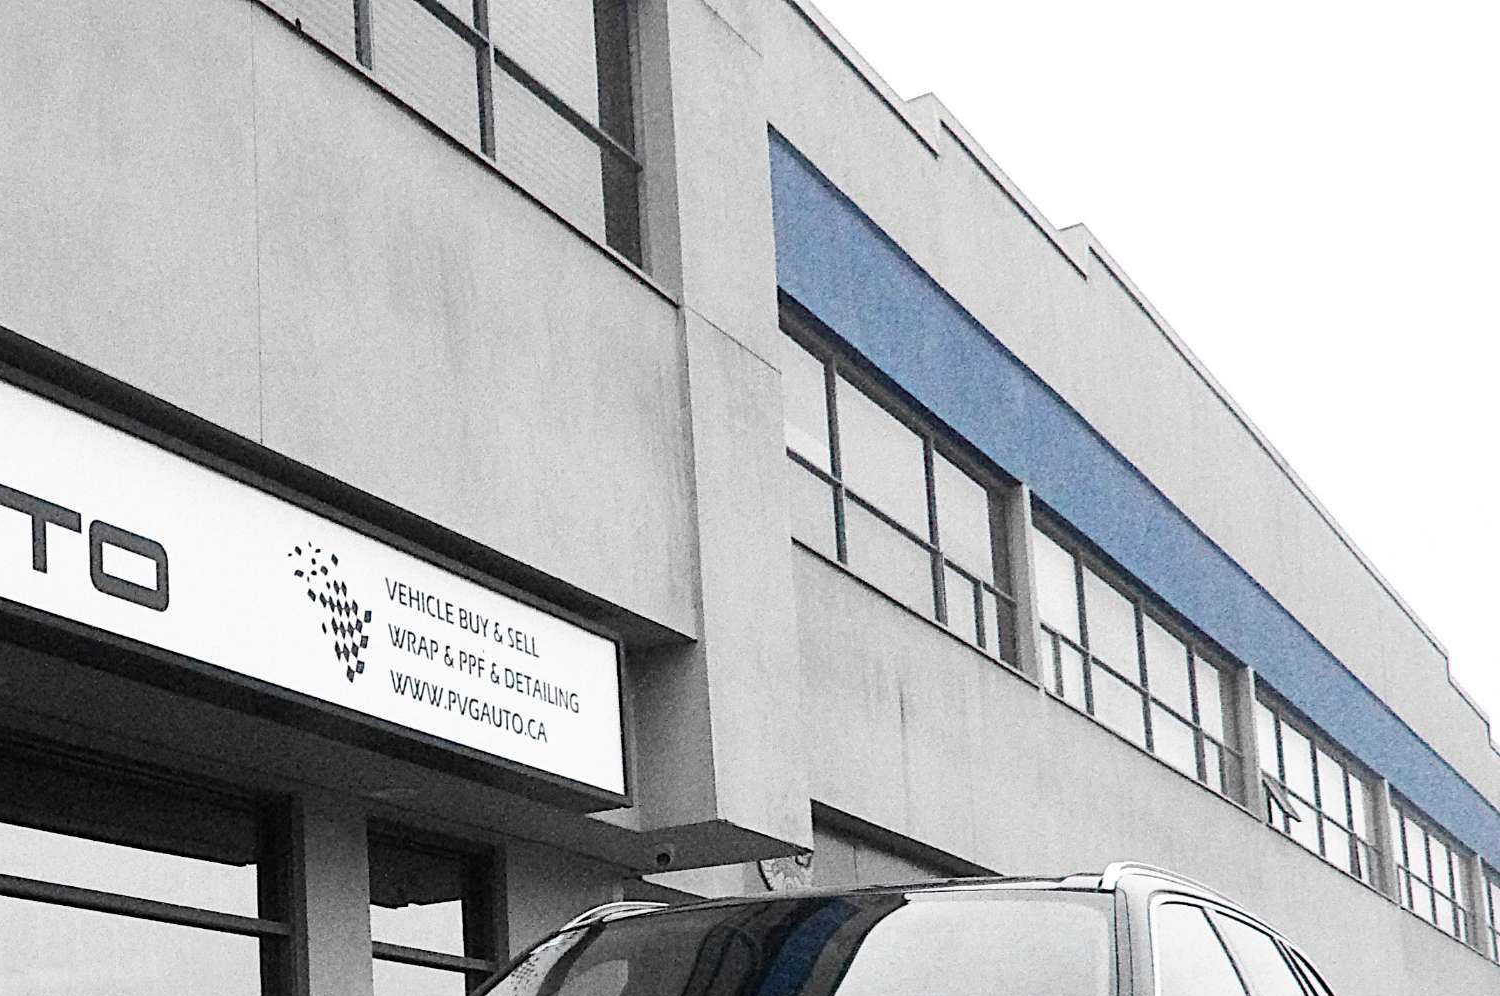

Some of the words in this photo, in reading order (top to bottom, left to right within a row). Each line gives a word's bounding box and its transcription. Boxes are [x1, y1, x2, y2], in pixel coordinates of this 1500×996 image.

[385, 577, 454, 624] VEHICLE
[458, 608, 489, 638] BUY
[493, 622, 504, 643] &
[507, 627, 540, 658] SELL
[388, 623, 439, 661] WRAP
[443, 646, 454, 668] &
[458, 651, 485, 678] PPF
[490, 662, 501, 684] &
[504, 668, 580, 714] DETAILING
[390, 669, 548, 743] WWW.PVGAUTO.CA
